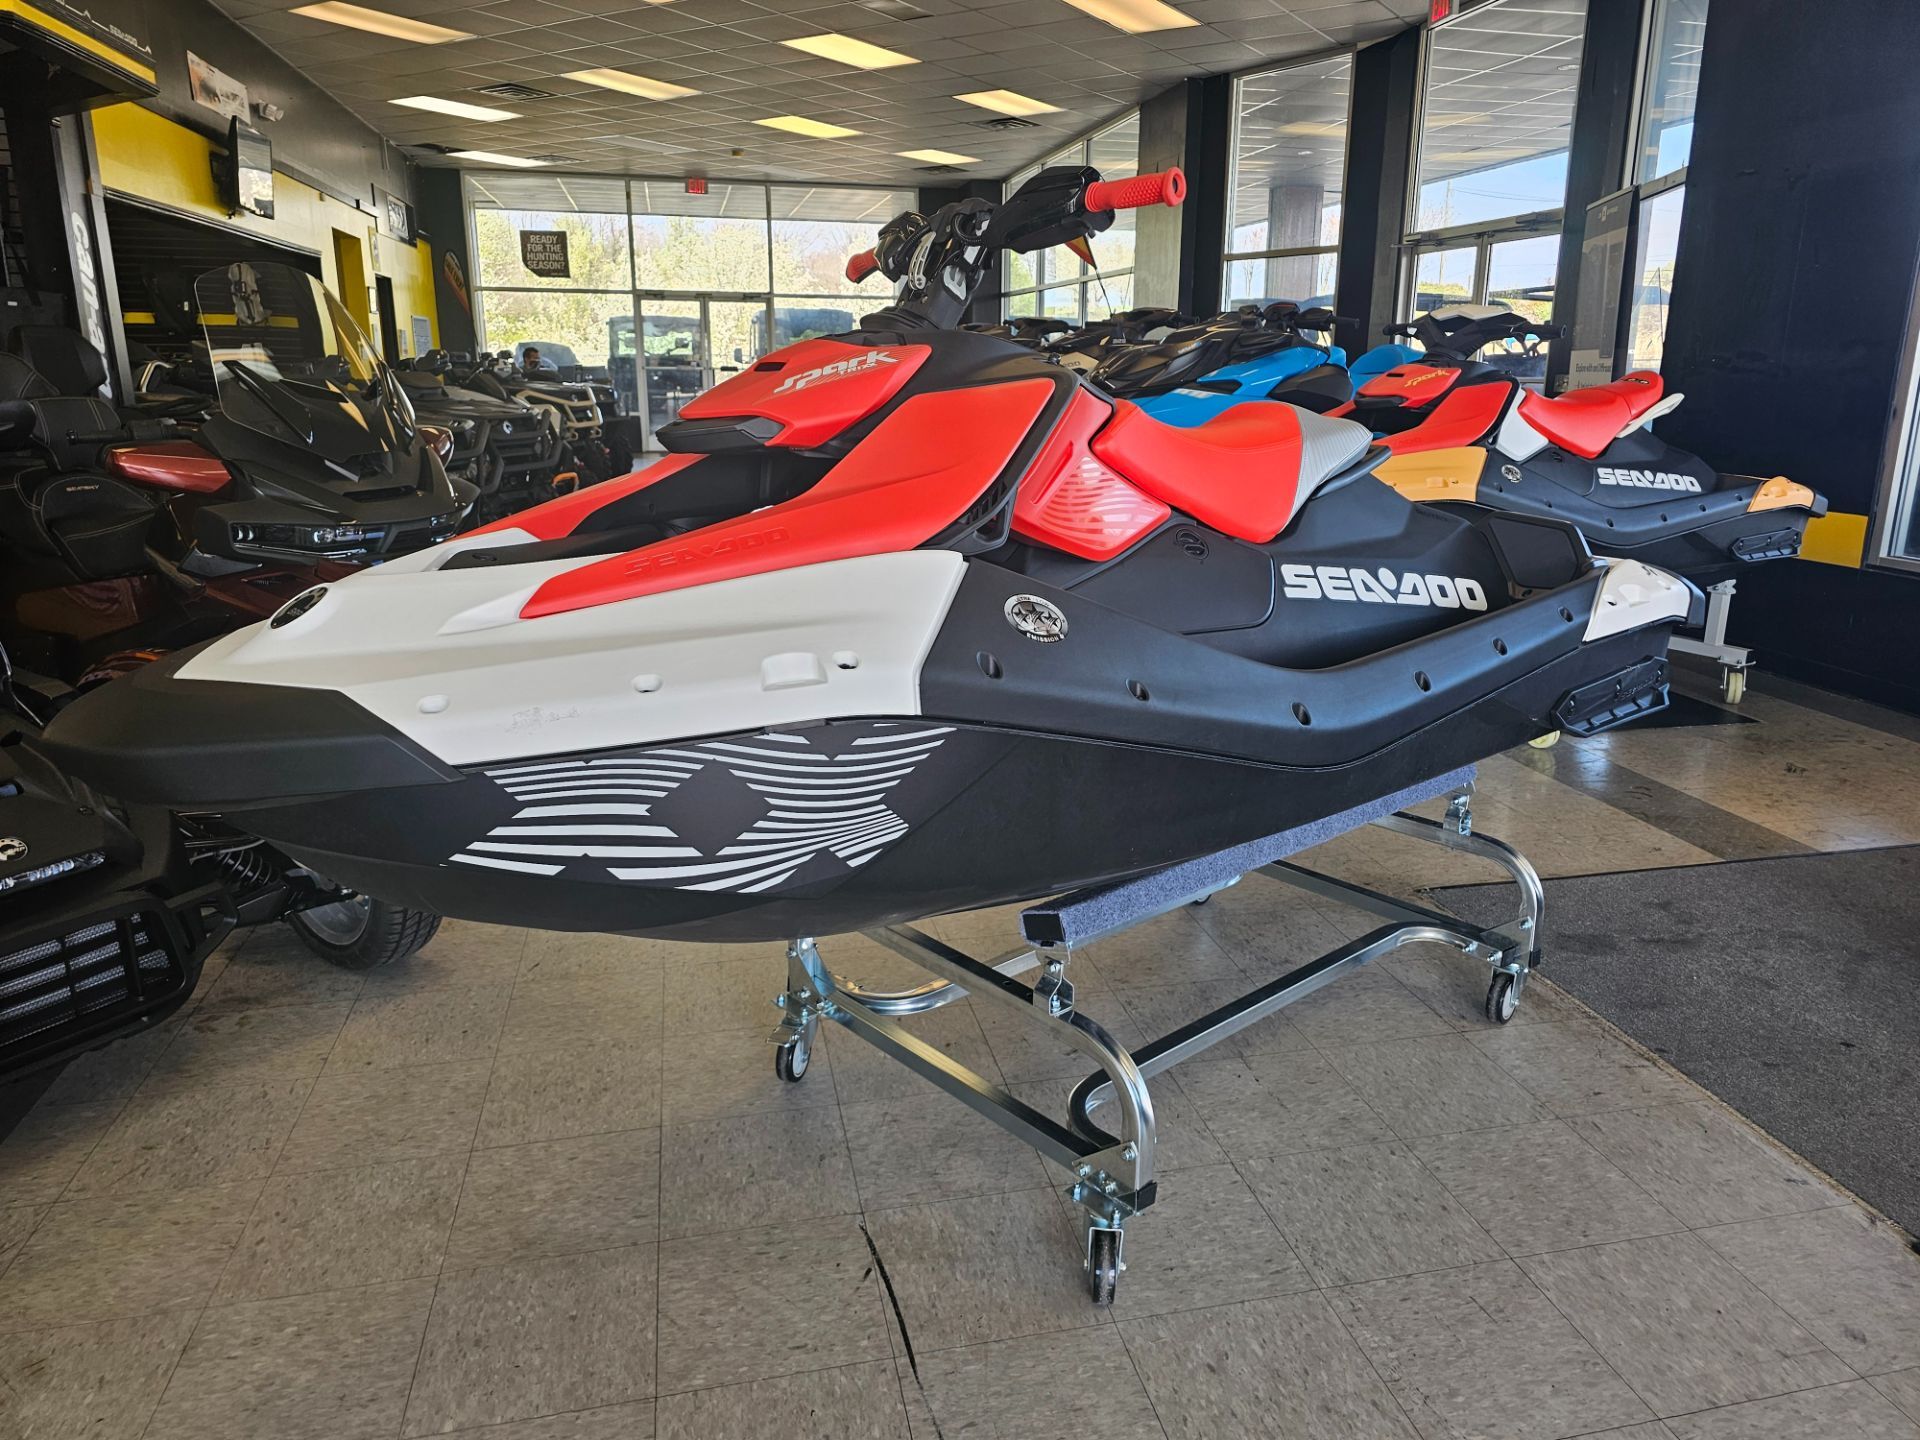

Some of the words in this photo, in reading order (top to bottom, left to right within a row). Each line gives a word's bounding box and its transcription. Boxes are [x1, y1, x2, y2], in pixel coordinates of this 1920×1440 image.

[688, 178, 705, 194] EXIT
[530, 235, 557, 244] READY
[527, 244, 543, 252] FOR
[545, 244, 562, 253] THE
[527, 252, 564, 261] HUNTING
[527, 261, 565, 270] SEASON?
